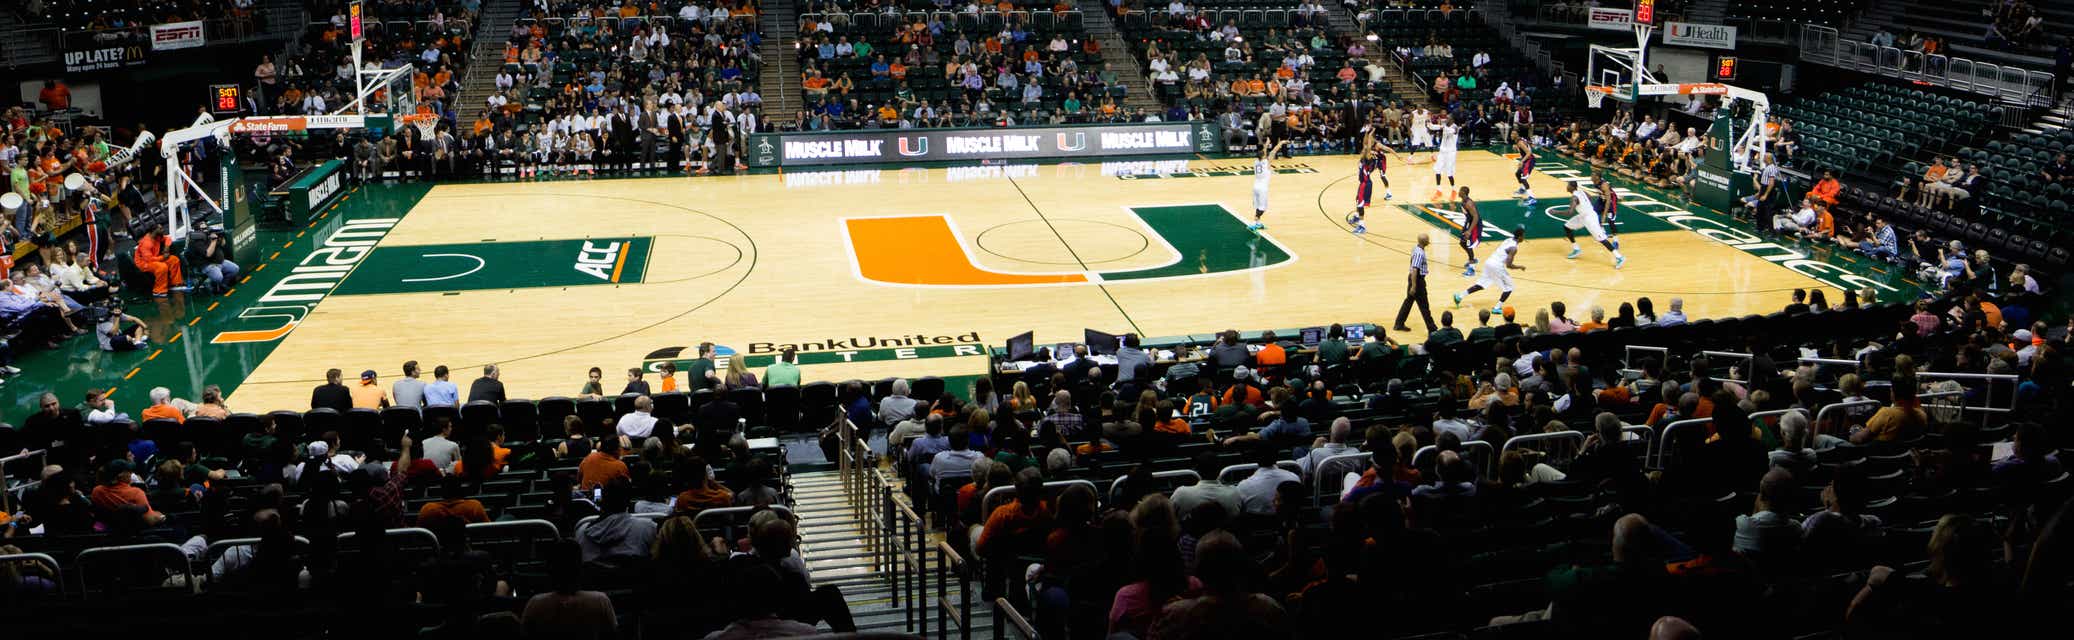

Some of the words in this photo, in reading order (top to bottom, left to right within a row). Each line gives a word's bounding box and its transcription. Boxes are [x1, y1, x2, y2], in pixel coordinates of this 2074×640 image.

[1592, 11, 1629, 22] ESPN
[155, 26, 200, 42] ESPN
[65, 51, 84, 65] UP
[85, 47, 125, 63] LATE?
[219, 88, 237, 97] 5:07
[219, 97, 235, 109] 28
[785, 140, 843, 159] MUSCLE
[844, 139, 882, 157] MILK
[946, 136, 1002, 154] MUSCLE
[1003, 135, 1040, 152] MILK
[1101, 131, 1154, 149] MUSCLE
[1155, 130, 1191, 148] MILK
[574, 240, 620, 281] ACC
[748, 332, 981, 354] BankUnited
[1192, 401, 1209, 417] 21
